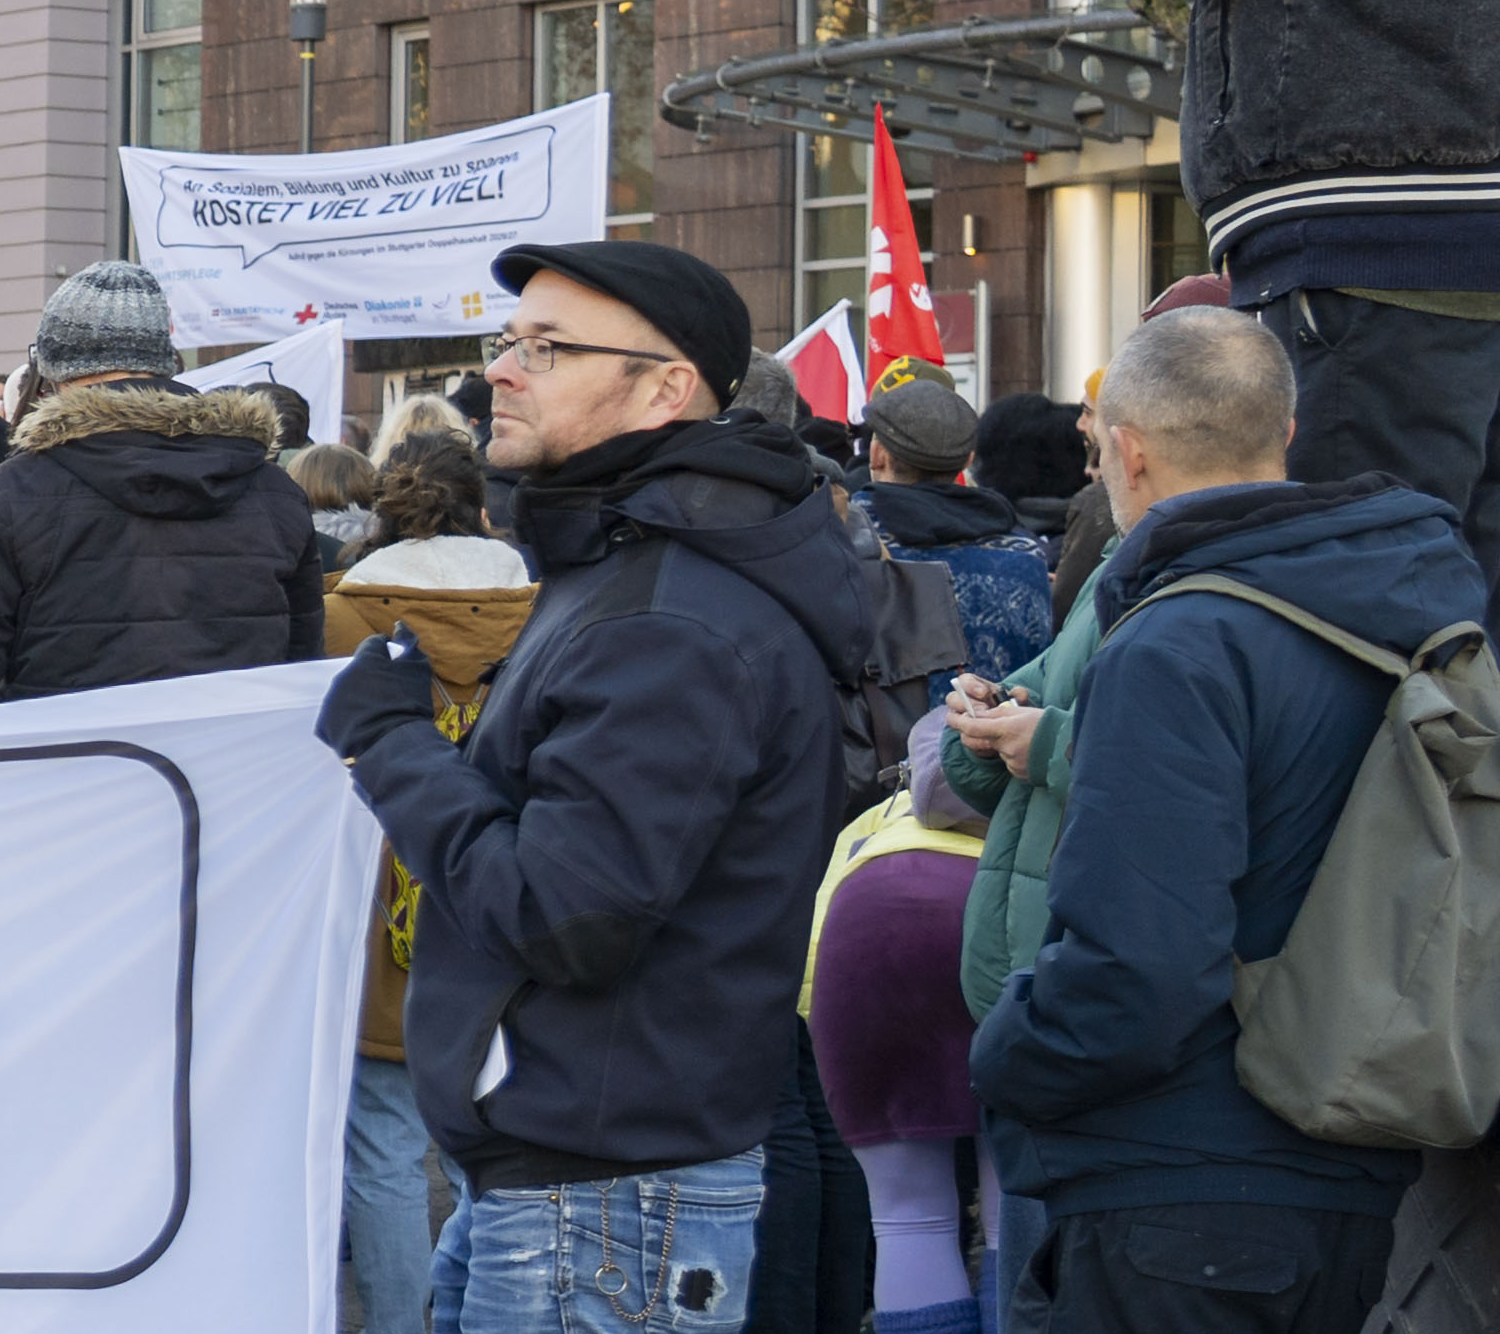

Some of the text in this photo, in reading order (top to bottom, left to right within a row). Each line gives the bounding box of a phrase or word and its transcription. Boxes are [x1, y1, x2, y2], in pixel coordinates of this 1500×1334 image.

[285, 178, 346, 196] Bildung
[350, 174, 378, 192] und
[381, 169, 436, 188] Kultur
[439, 164, 461, 177] zu
[193, 169, 505, 227] KOSTET VIEL ZU VIEL!
[364, 298, 411, 311] Diakonie
